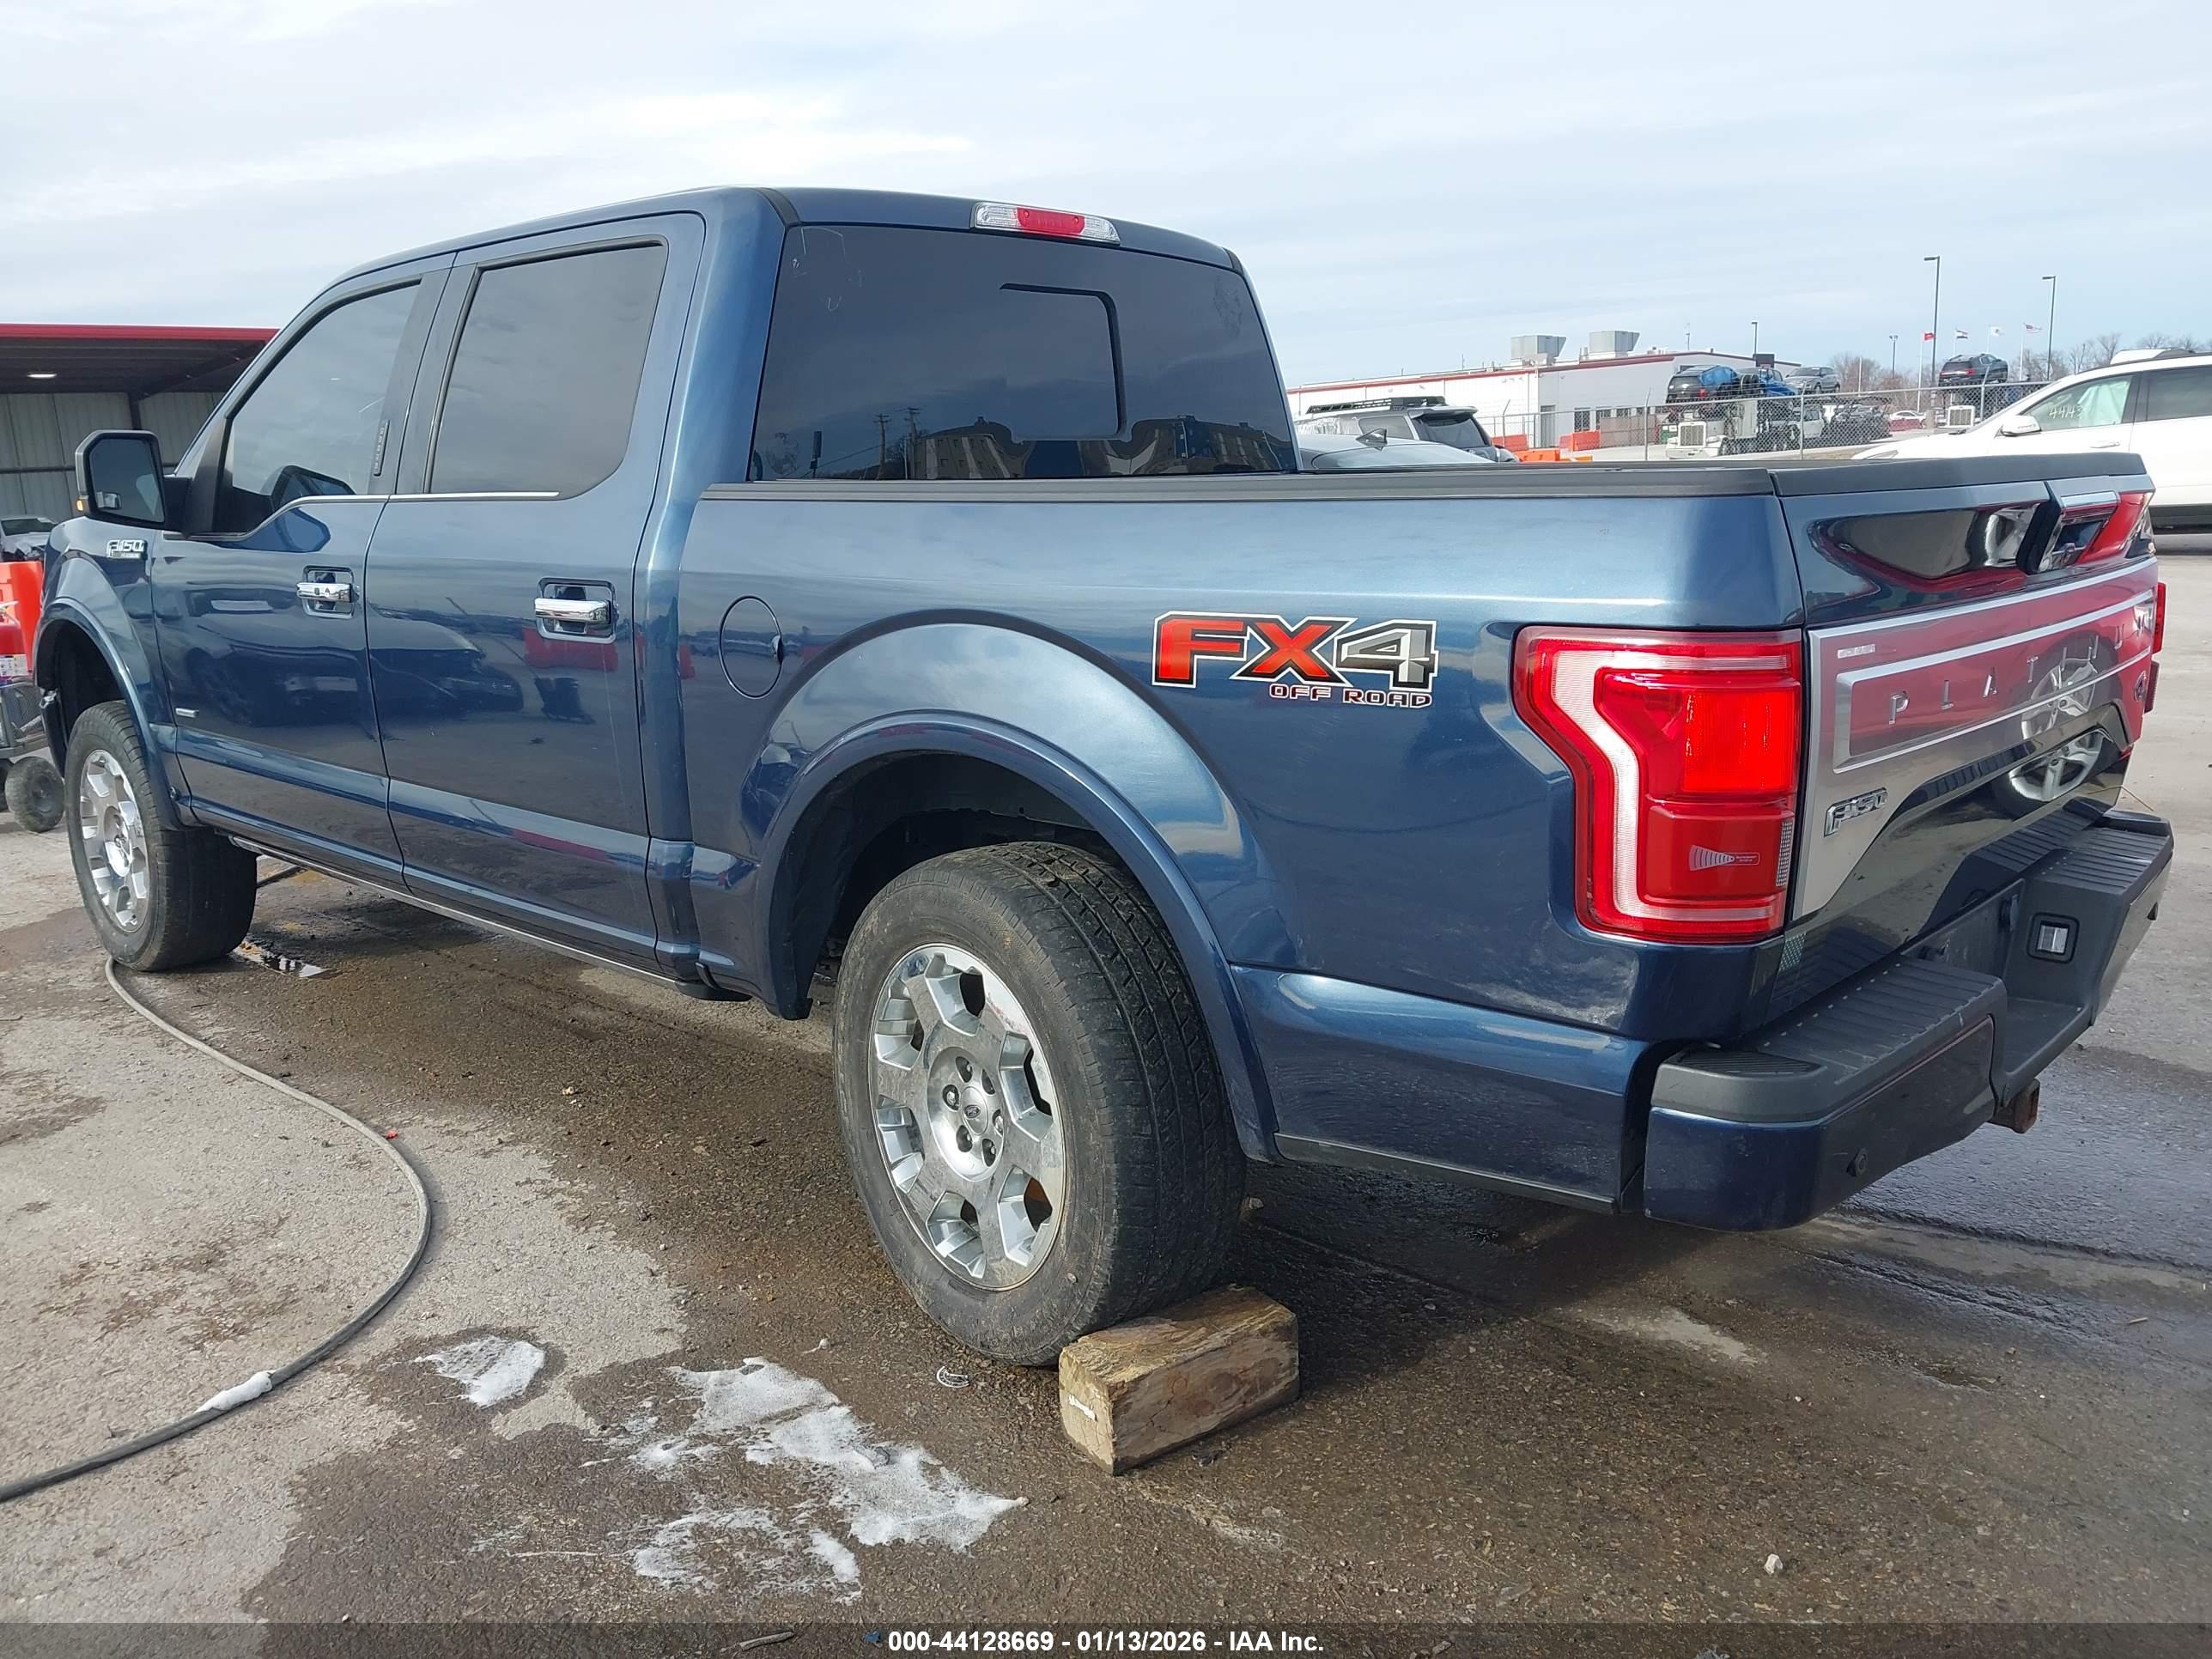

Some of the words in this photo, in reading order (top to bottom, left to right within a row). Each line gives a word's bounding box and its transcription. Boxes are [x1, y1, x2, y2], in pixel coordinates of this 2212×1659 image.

[1152, 611, 1438, 692] FX4
[1269, 683, 1331, 701] OFF
[1343, 686, 1432, 708] ROAD
